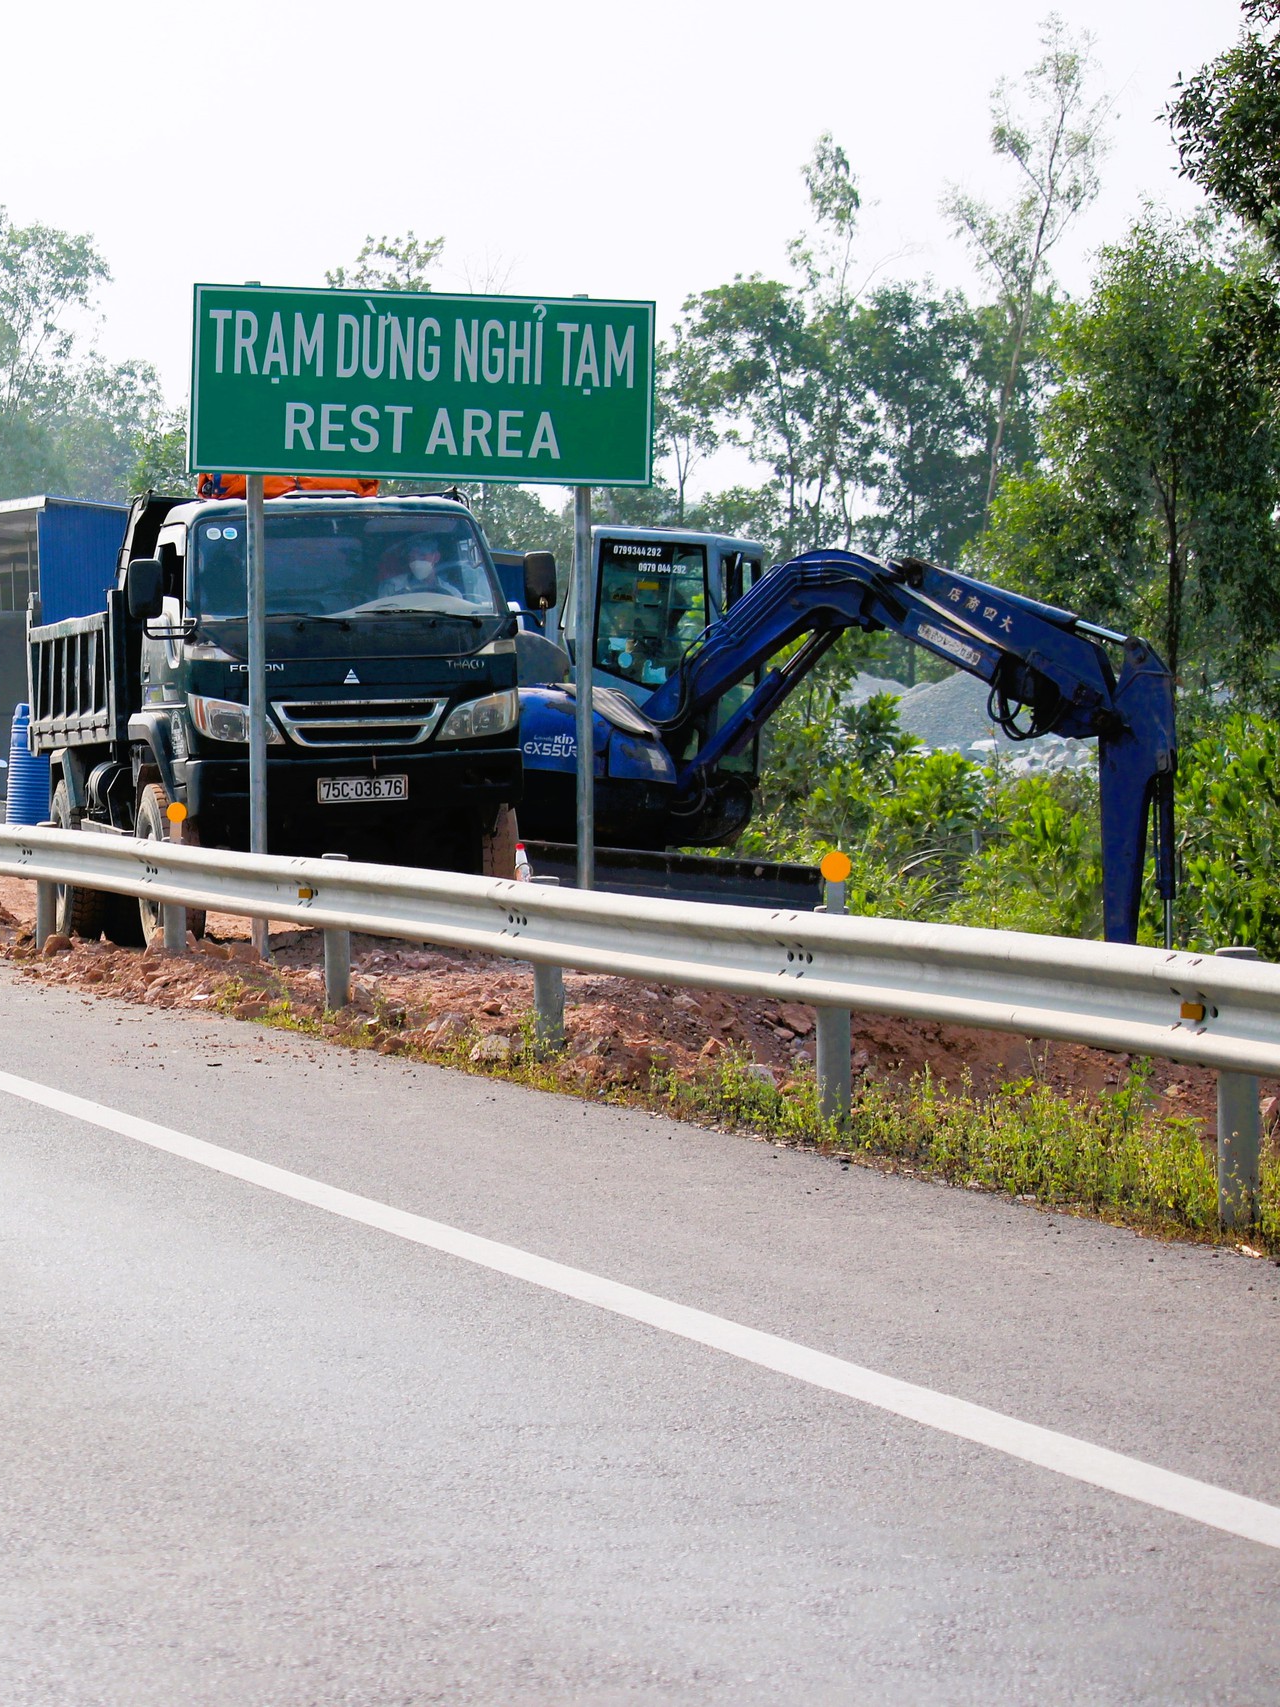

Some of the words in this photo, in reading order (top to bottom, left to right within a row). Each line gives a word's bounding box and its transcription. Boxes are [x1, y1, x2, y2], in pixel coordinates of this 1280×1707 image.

[209, 309, 325, 384] TRẠM
[336, 300, 441, 383] DỪNG
[453, 304, 548, 385] NGHỈ
[557, 322, 635, 395] TẠM
[284, 402, 413, 454] REST
[425, 407, 561, 459] AREA
[229, 663, 285, 673] FOON
[445, 658, 485, 670] THACO
[322, 780, 403, 799] 75C-036.76
